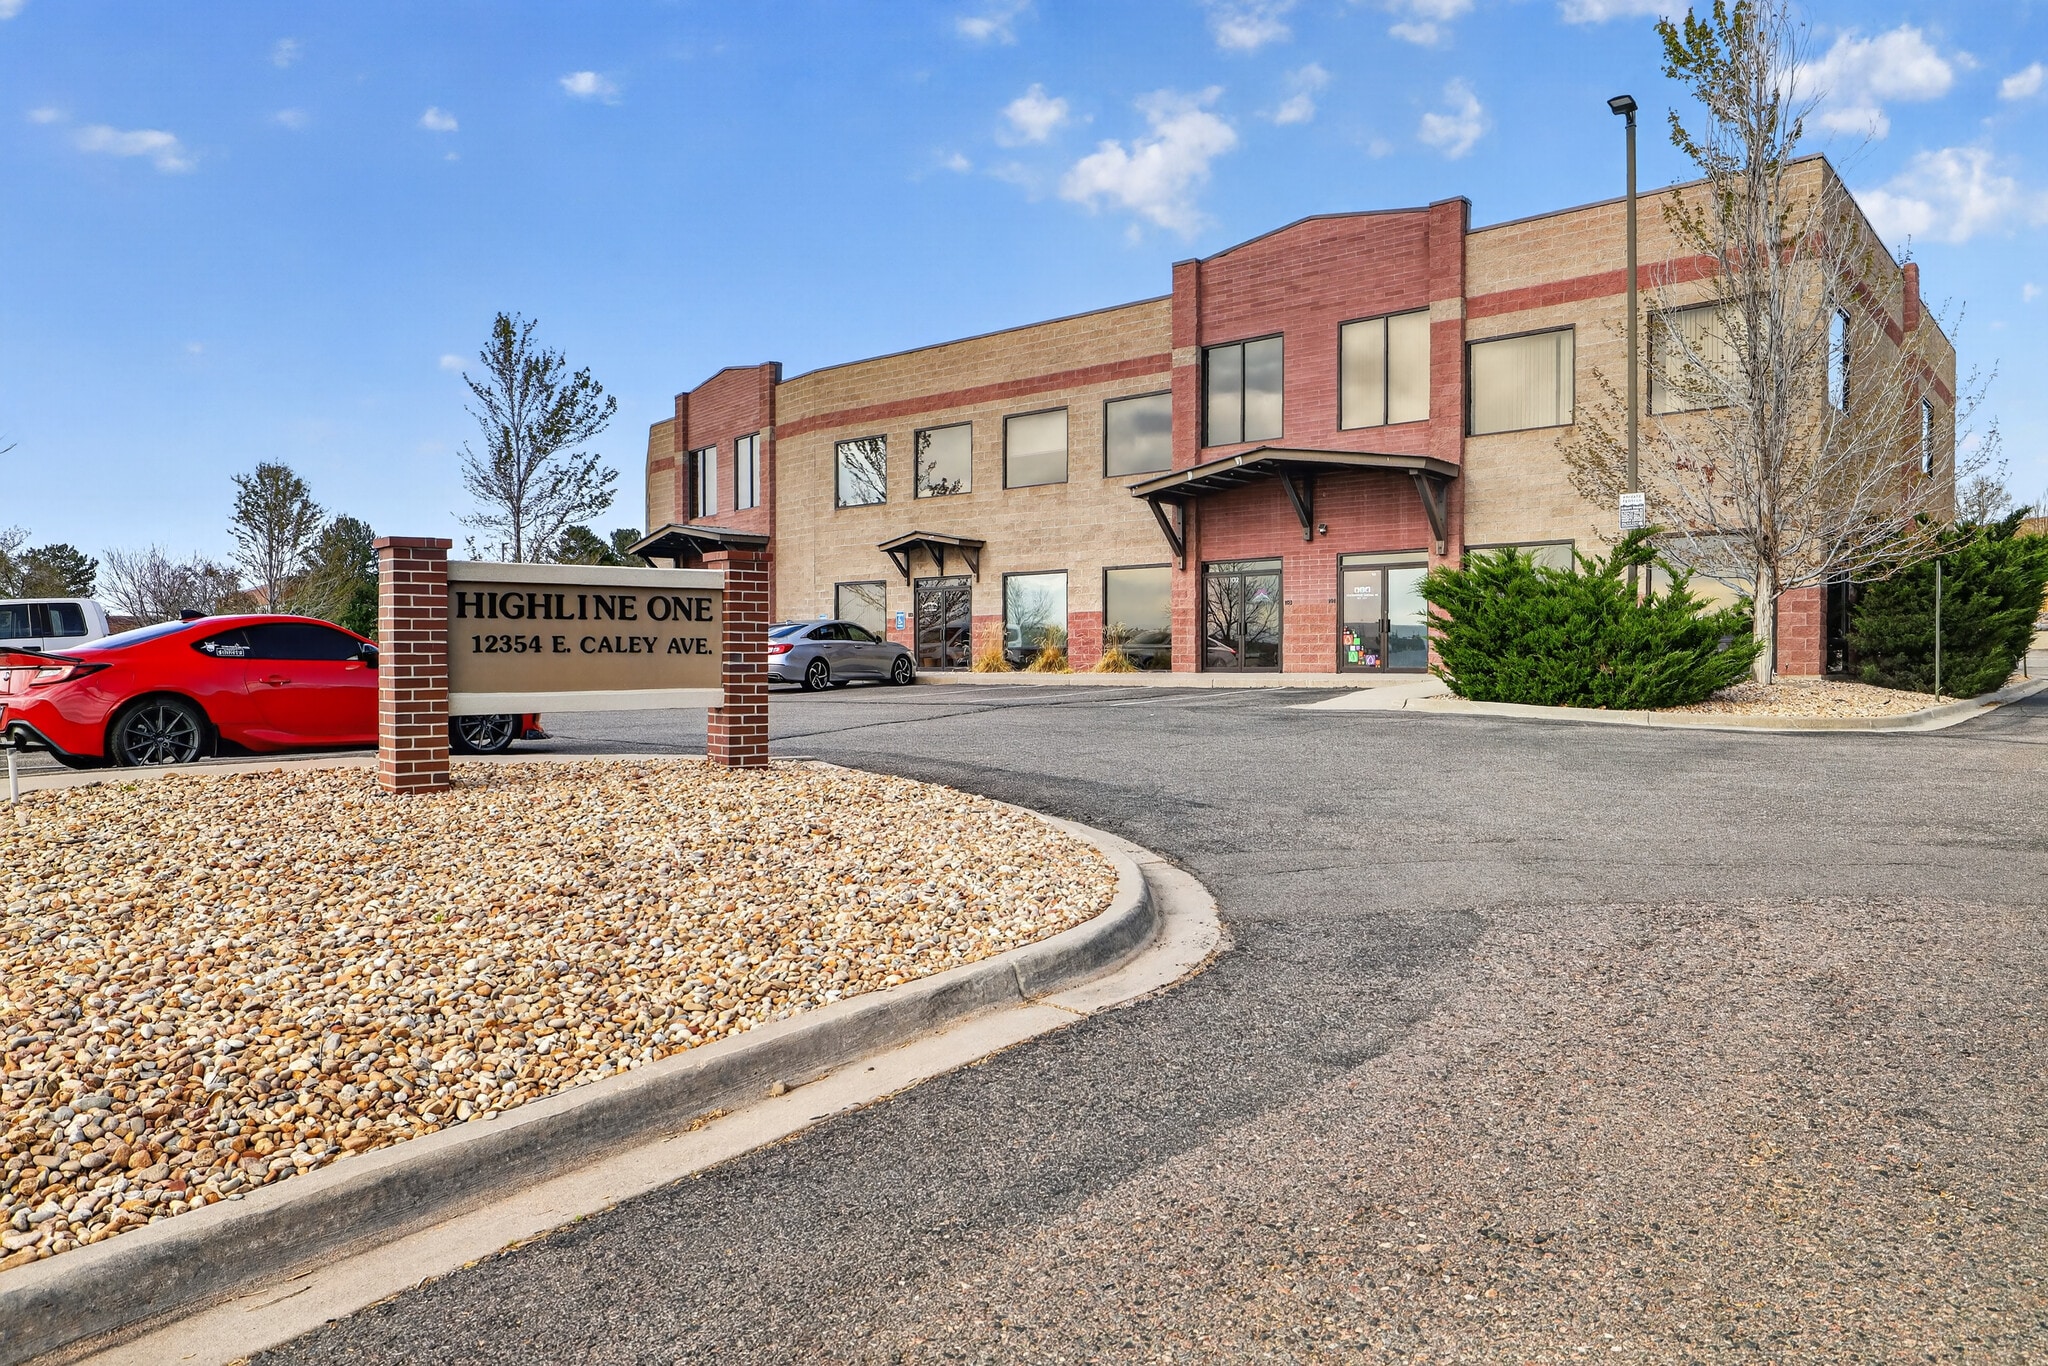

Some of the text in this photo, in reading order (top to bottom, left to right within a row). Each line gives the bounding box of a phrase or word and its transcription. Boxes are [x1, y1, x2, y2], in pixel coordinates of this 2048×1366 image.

[456, 591, 714, 622] HIGHLINE ONE
[471, 634, 713, 655] 12354 E. CALEY AVE.
